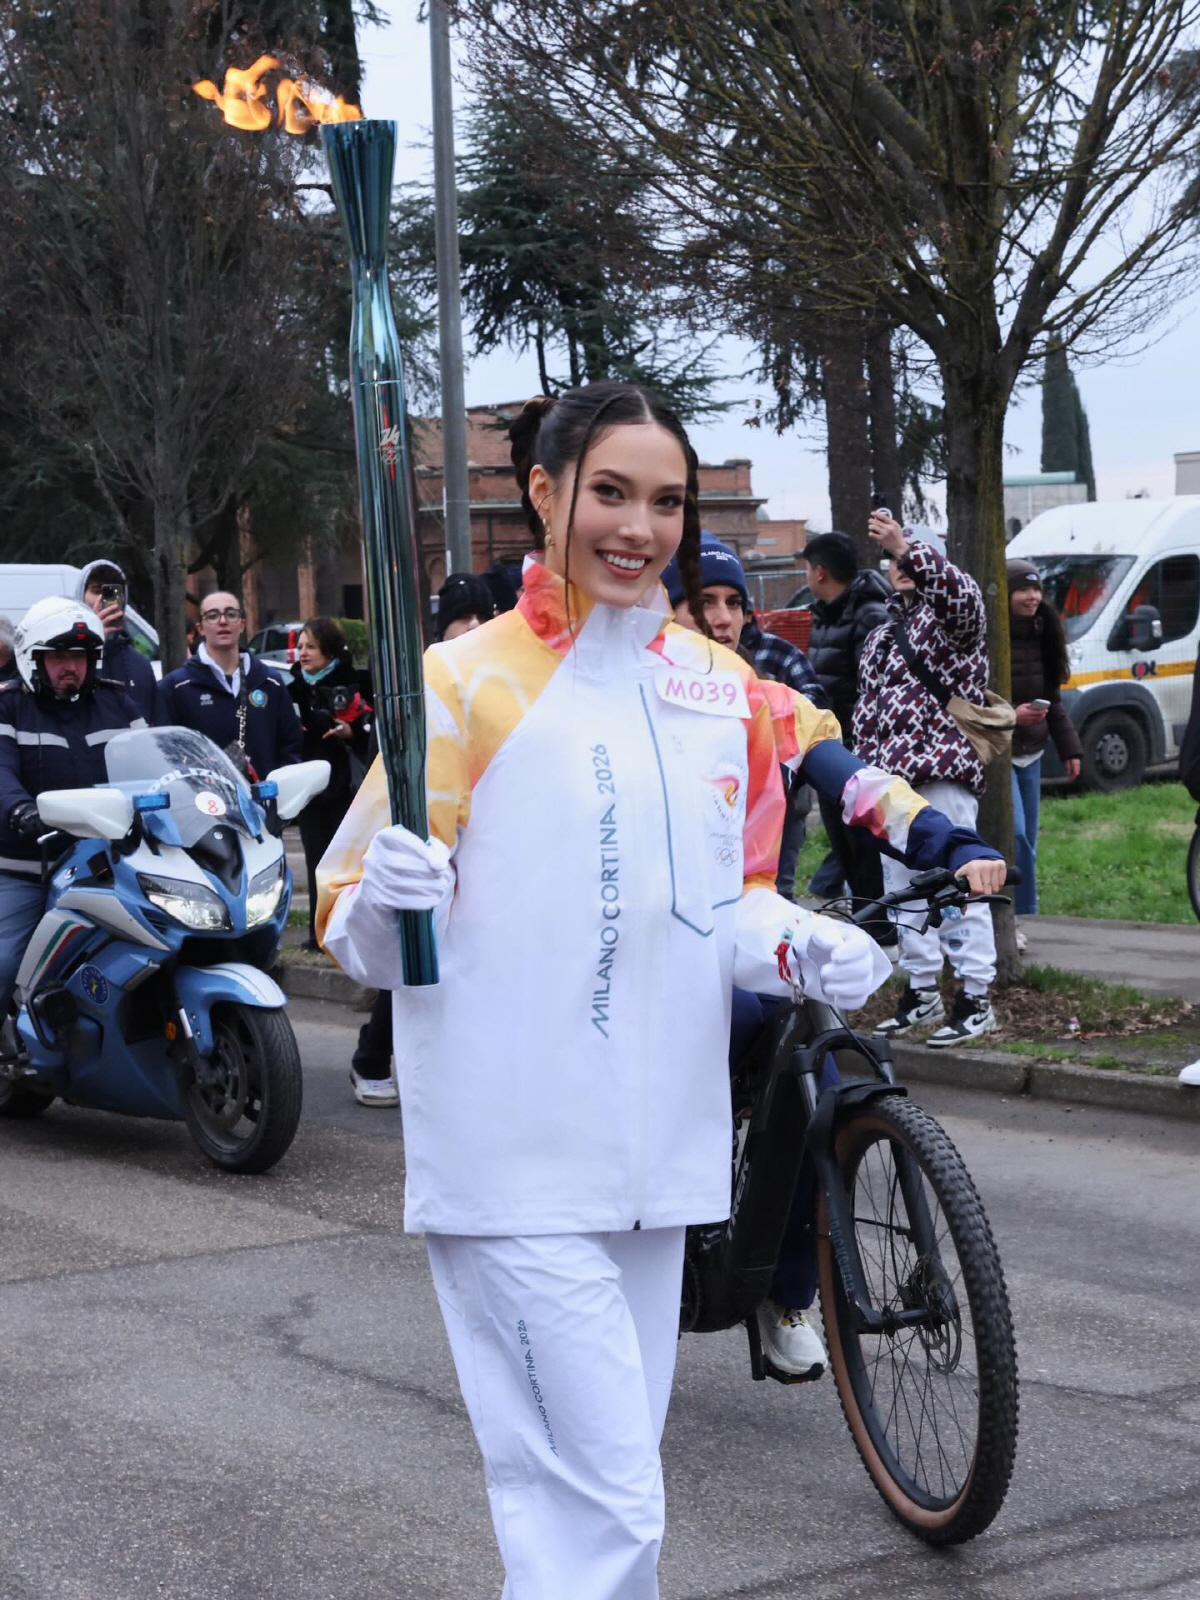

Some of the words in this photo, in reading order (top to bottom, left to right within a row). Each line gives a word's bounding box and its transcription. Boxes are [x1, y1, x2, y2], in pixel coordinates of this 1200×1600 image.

[665, 677, 737, 706] M039
[590, 743, 615, 795] 2026
[208, 799, 219, 814] 8
[600, 803, 621, 920] CORTINA
[591, 926, 621, 1039] MILANO
[517, 1319, 530, 1346] 2026
[525, 1349, 543, 1404] CORTINA
[538, 1405, 559, 1458] MILANO
